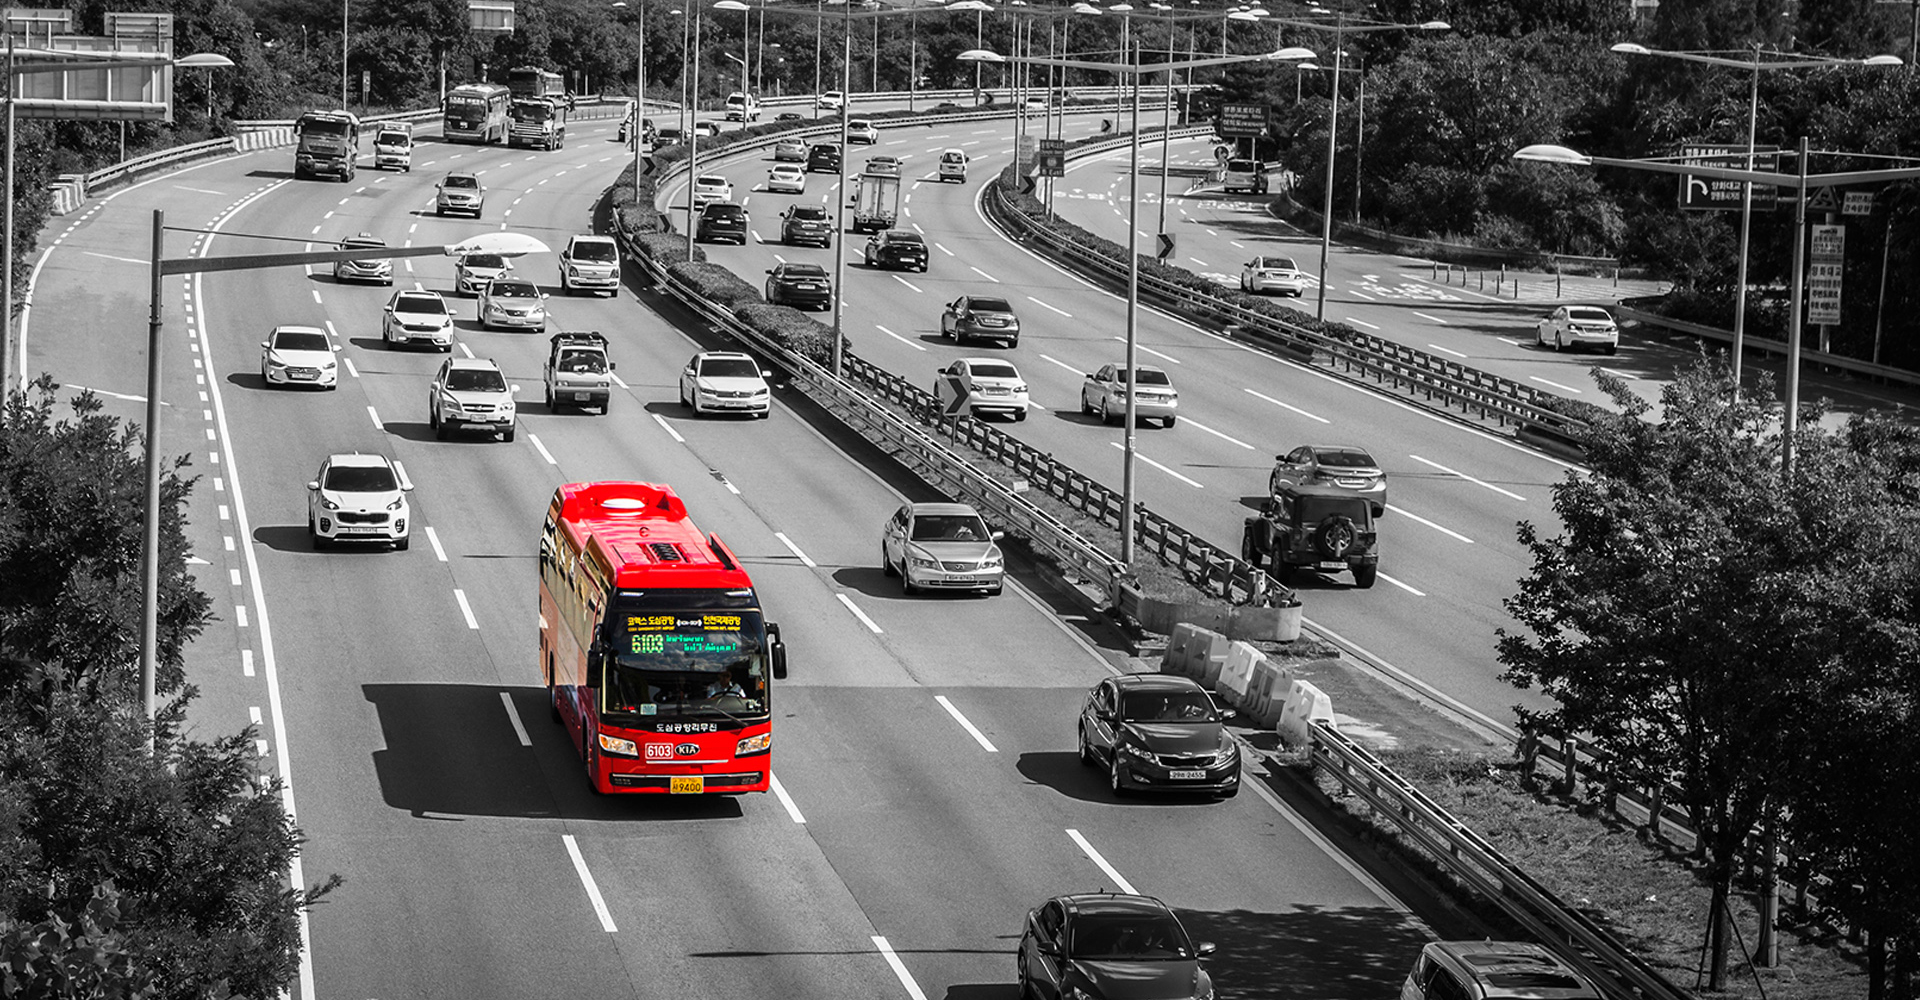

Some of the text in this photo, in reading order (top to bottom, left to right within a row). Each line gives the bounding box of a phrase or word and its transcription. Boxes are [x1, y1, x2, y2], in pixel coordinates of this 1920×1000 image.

[648, 616, 674, 625] 도심공항
[703, 615, 741, 626] 인천국제공항
[632, 634, 664, 653] 6103
[656, 723, 717, 732] 도심공항리무진
[648, 746, 671, 756] 6103
[679, 783, 701, 792] 9400
